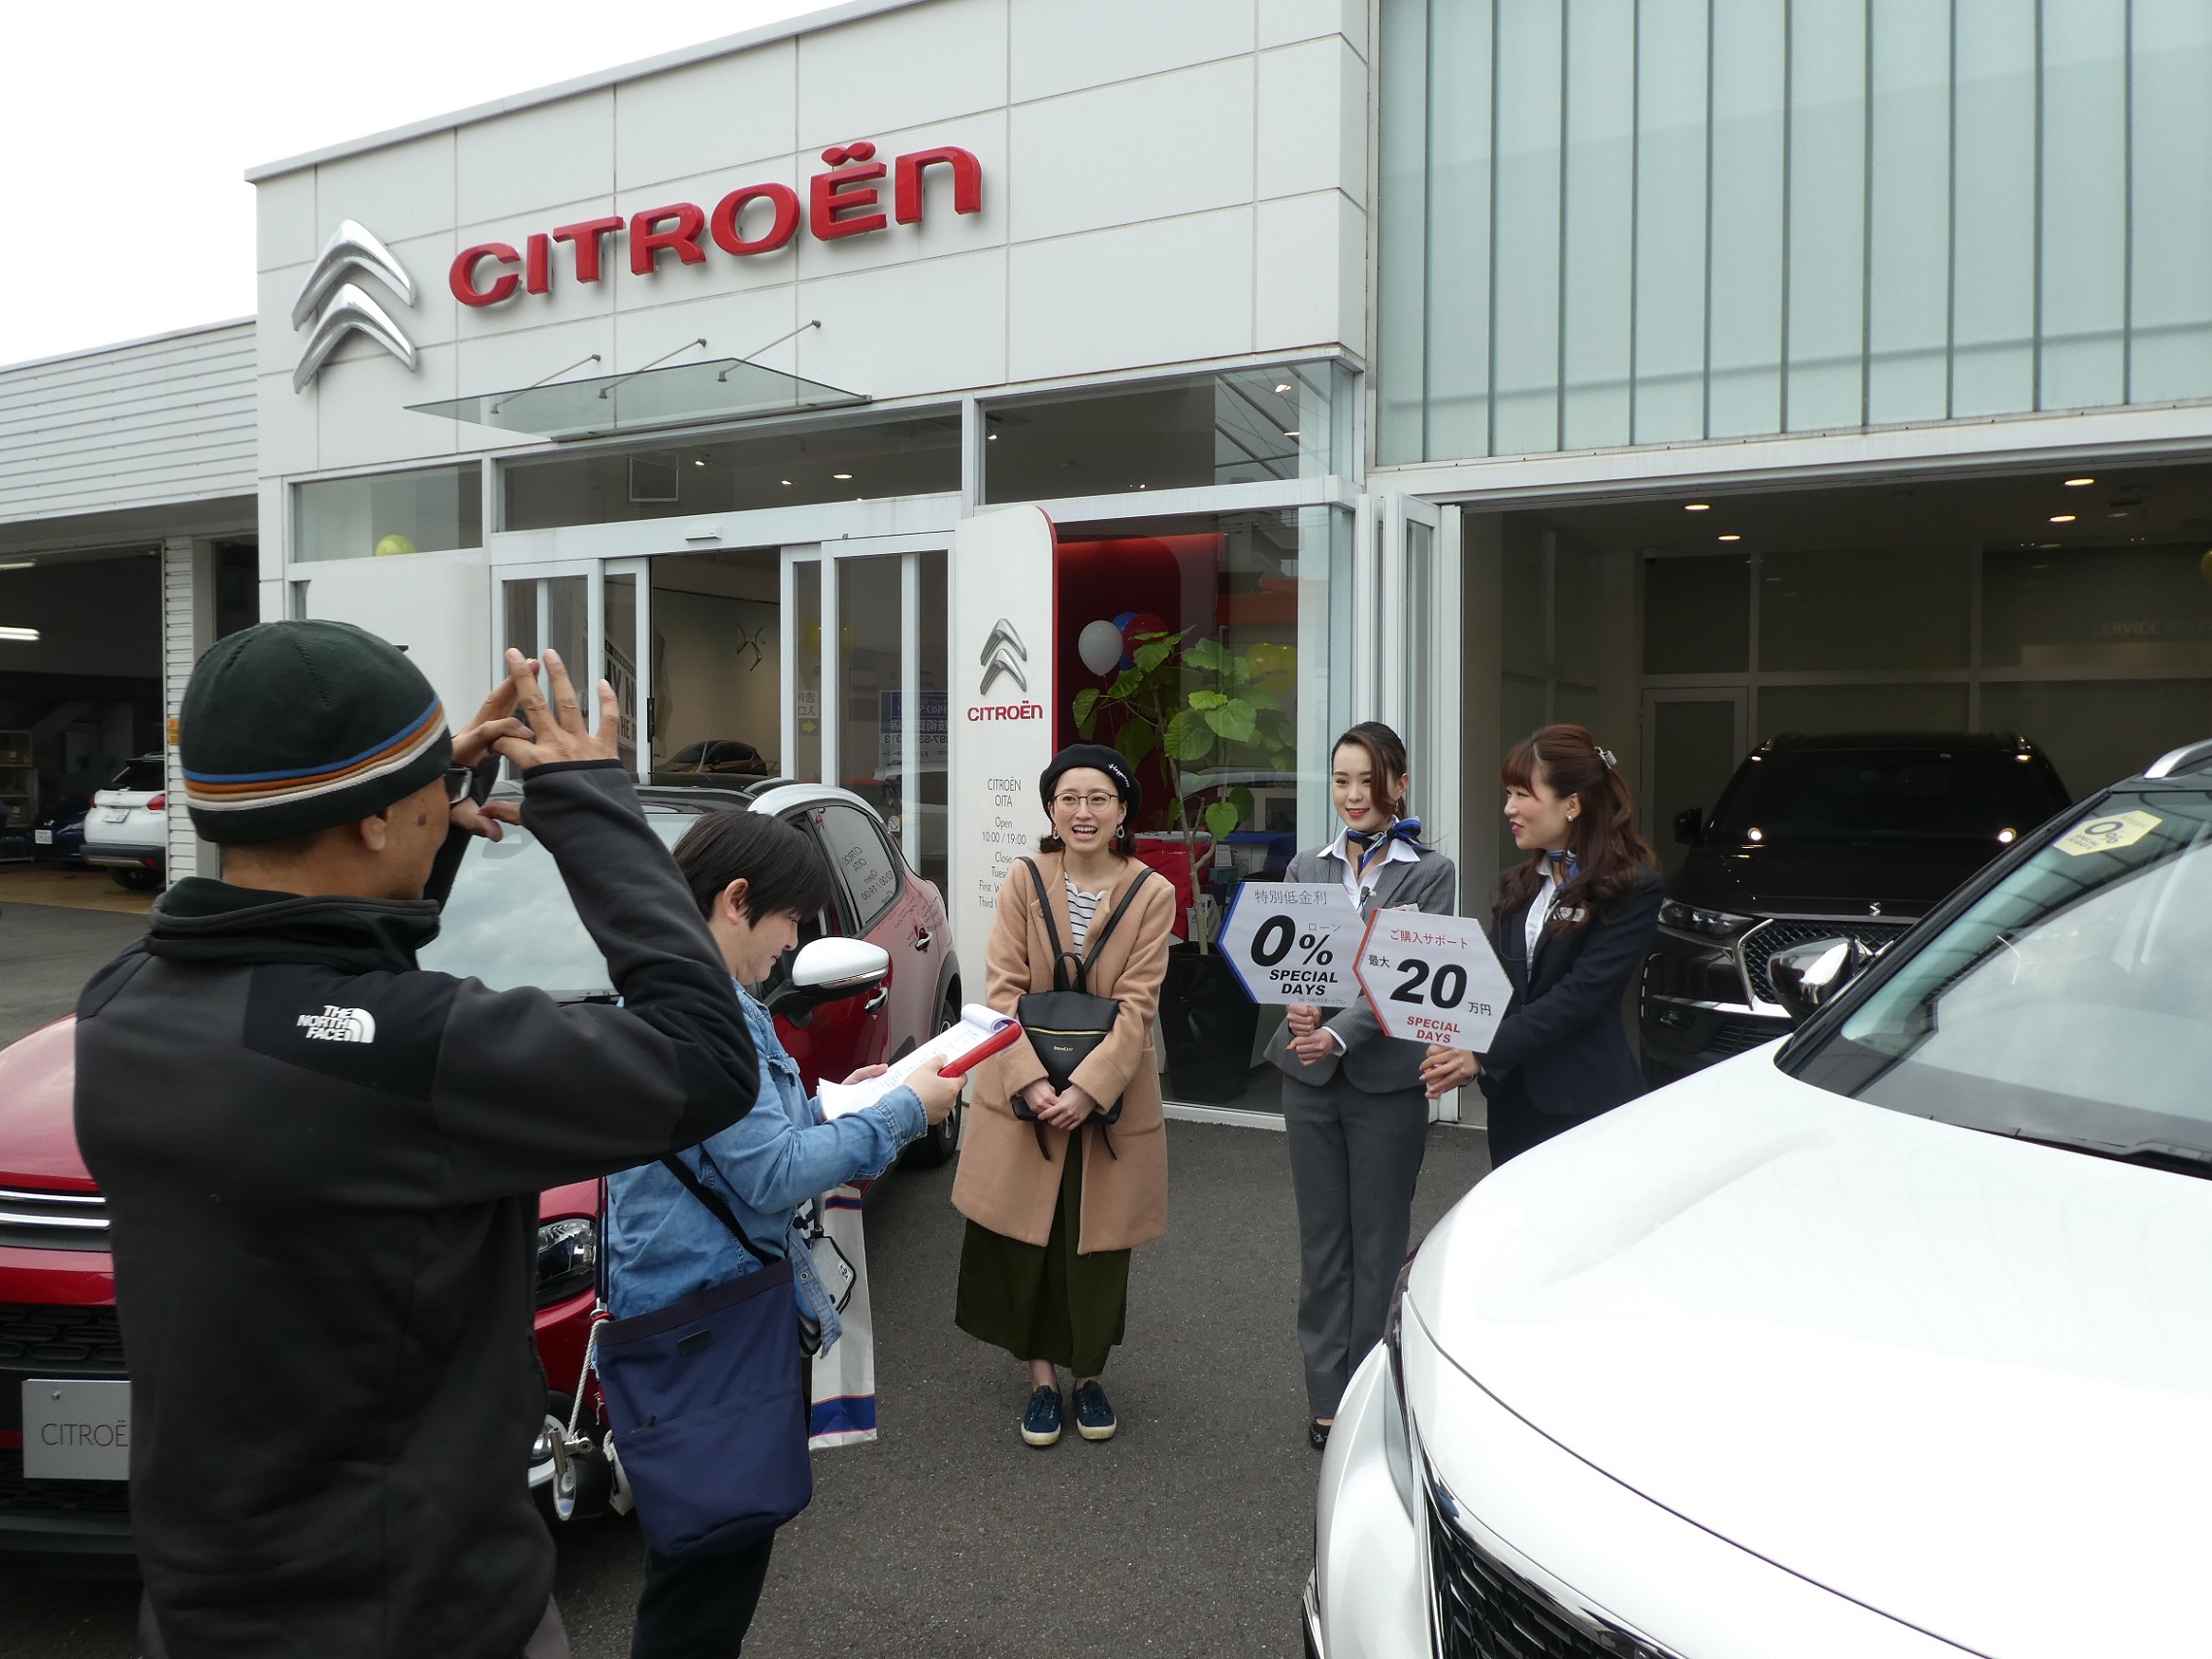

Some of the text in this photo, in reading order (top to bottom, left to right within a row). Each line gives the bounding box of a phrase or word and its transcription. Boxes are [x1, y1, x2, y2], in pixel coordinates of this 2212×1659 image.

[988, 776, 1022, 792] CITROËN
[994, 795, 1013, 807] OITA
[994, 816, 1013, 830] Open
[982, 831, 1000, 843] 10:00
[1007, 834, 1026, 845] 19:00
[994, 852, 1013, 863] Close
[979, 880, 992, 892] First
[979, 895, 993, 908] Third
[1254, 890, 1327, 905] 特別低金利
[1308, 923, 1342, 931] ローン
[1250, 915, 1333, 967] 0%
[1389, 928, 1468, 950] ご購入サポート
[1269, 969, 1339, 984] SPECIAL
[1281, 984, 1326, 995] DAYS
[1368, 954, 1492, 1016] 最大 20 万円
[324, 1004, 353, 1018] THE
[297, 1015, 350, 1028] NORTH
[1407, 1016, 1461, 1033] SPECIAL
[306, 1026, 346, 1041] FACE
[1415, 1029, 1451, 1043] DAYS
[42, 1419, 129, 1447] CITROË
